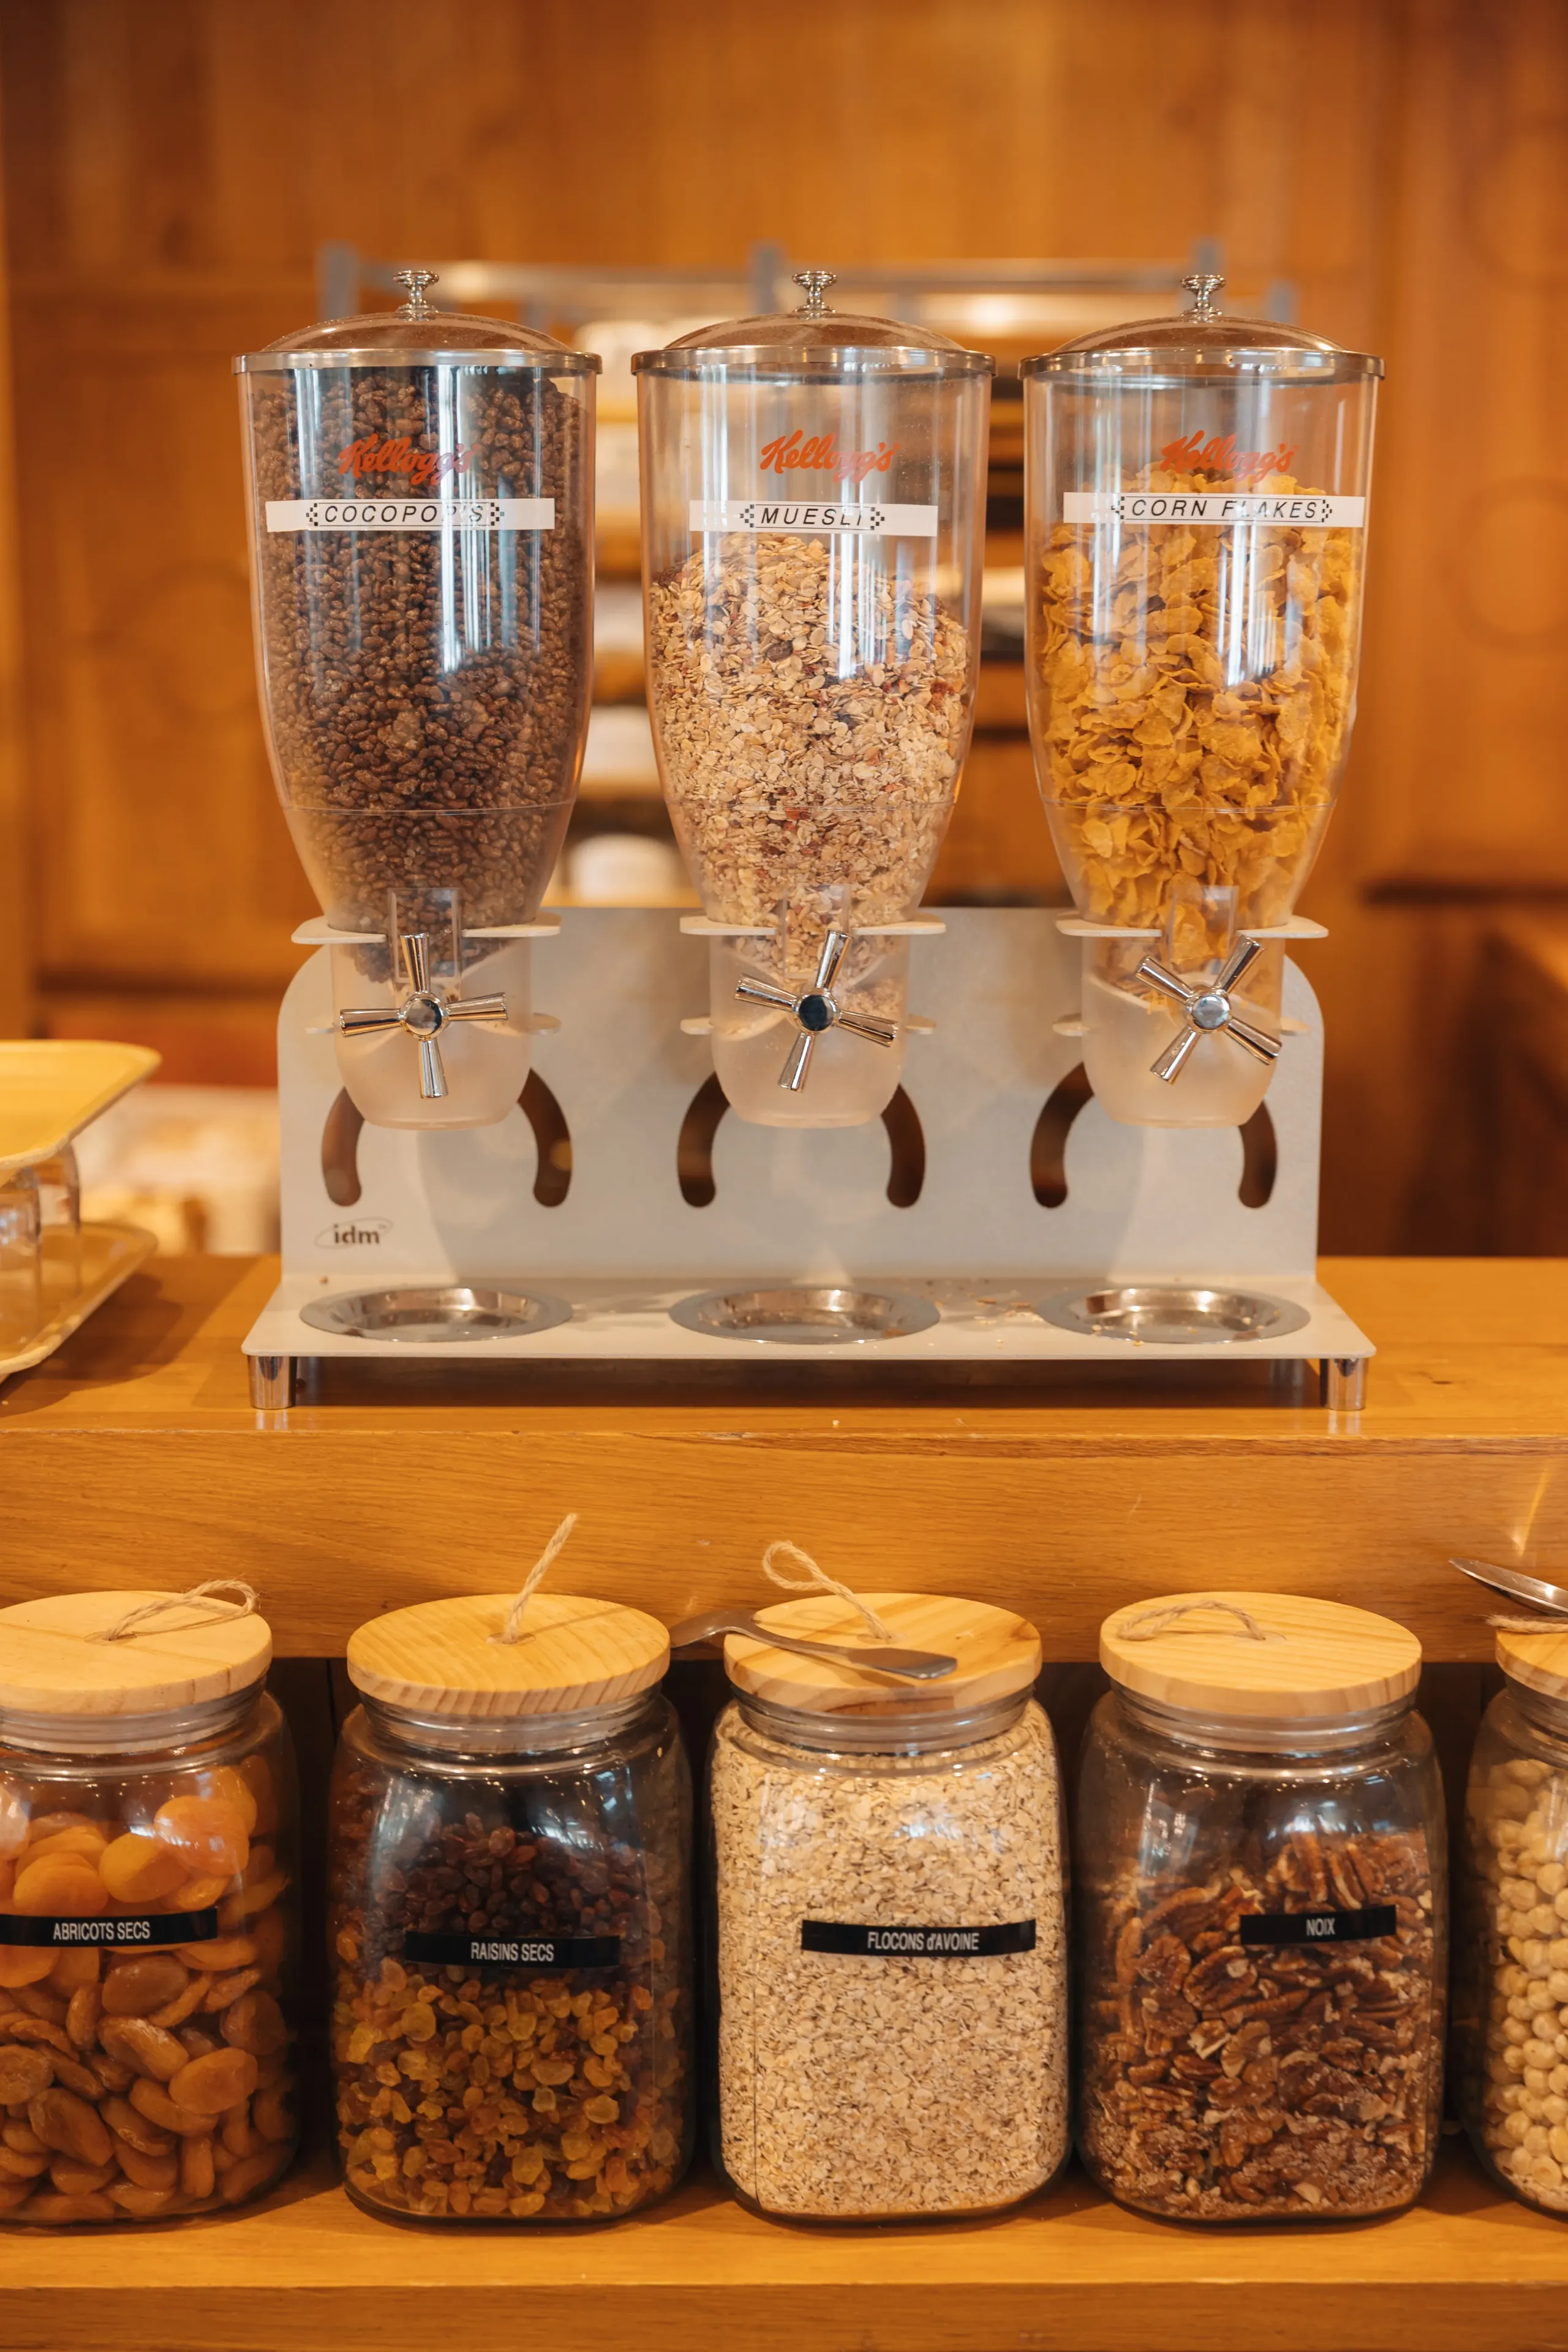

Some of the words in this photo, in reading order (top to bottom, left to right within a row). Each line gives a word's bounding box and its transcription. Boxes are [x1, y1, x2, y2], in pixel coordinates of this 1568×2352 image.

[760, 430, 898, 483] Kellogg's
[1159, 431, 1297, 483] Kellogg's
[761, 507, 863, 527] MUESLI
[1132, 499, 1208, 517] CORN
[1221, 500, 1317, 519] FLAKES
[333, 1224, 380, 1244] idm
[53, 1922, 115, 1940] ABRICOTS
[117, 1921, 151, 1939] SECS
[1306, 1918, 1335, 1936] NOIX
[867, 1931, 924, 1951] FLOCONS
[926, 1932, 980, 1951] d'AVOINE
[470, 1942, 519, 1961] RAISINS
[521, 1943, 554, 1962] SECS
